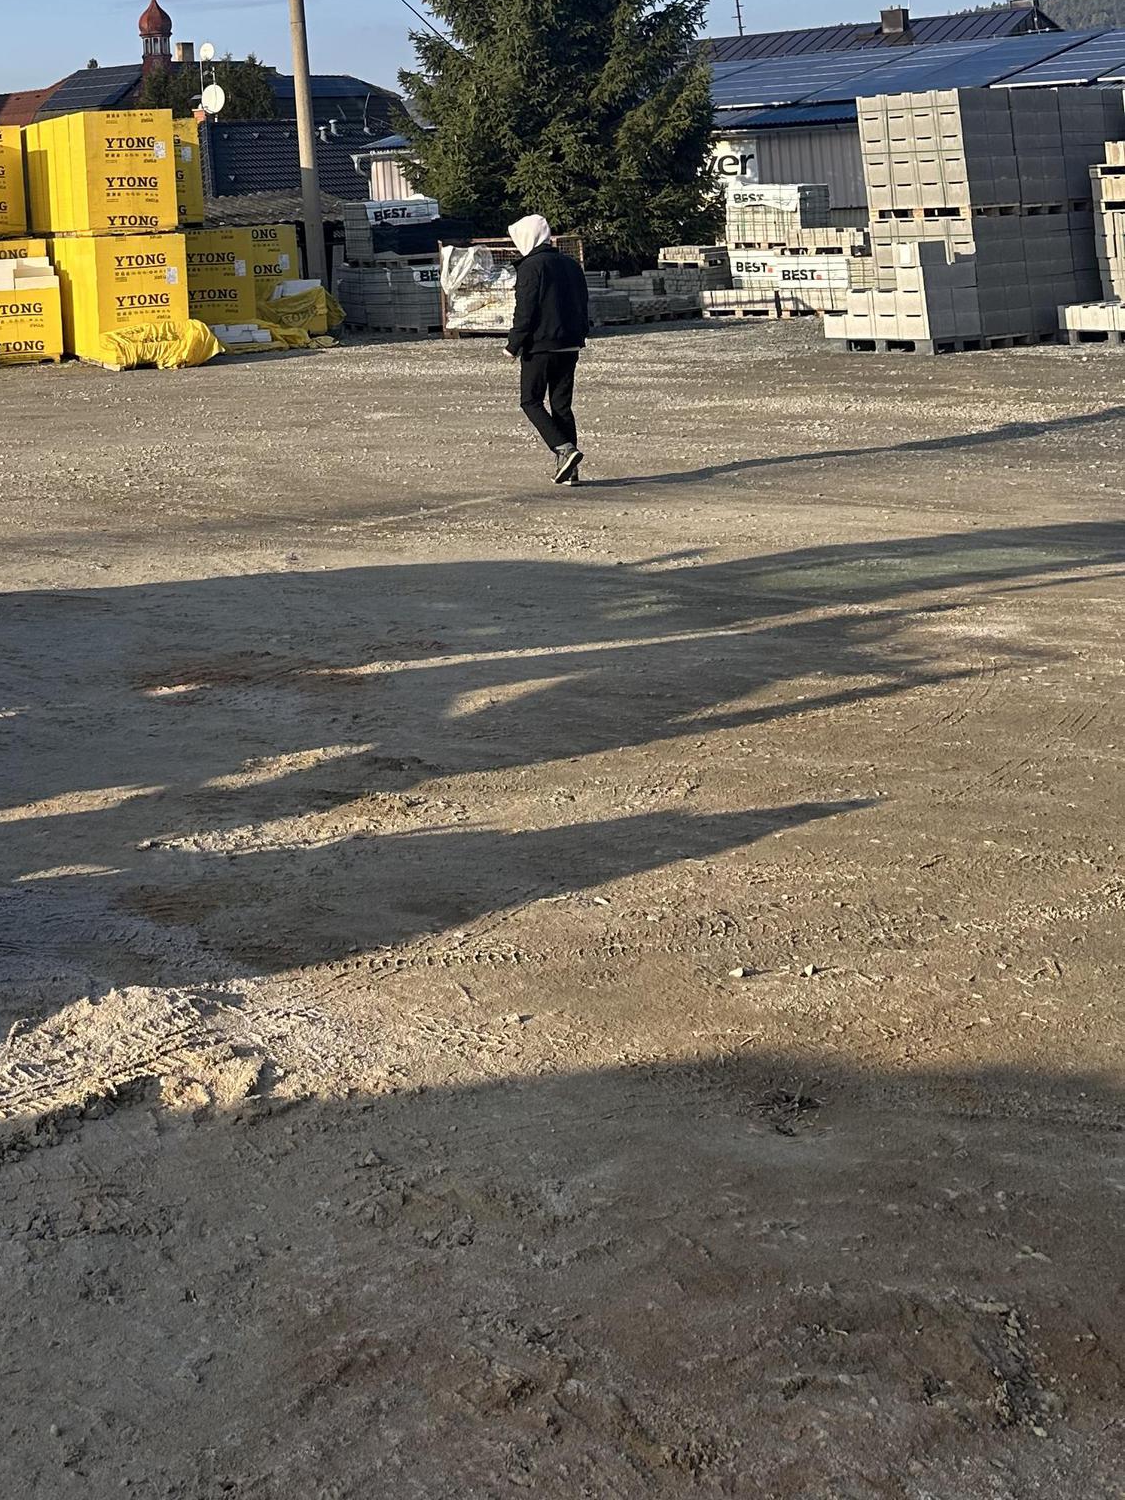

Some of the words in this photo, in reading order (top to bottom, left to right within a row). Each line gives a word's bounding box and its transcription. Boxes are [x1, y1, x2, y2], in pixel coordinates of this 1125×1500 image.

[105, 136, 155, 148] YTONG
[105, 176, 158, 188] YTONG
[107, 215, 159, 226] YTONG
[251, 228, 277, 240] ONG
[114, 252, 166, 267] YTONG
[187, 251, 236, 263] YTONG
[253, 264, 283, 275] ONG
[116, 292, 170, 307] YTONG
[189, 288, 238, 300] YTONG
